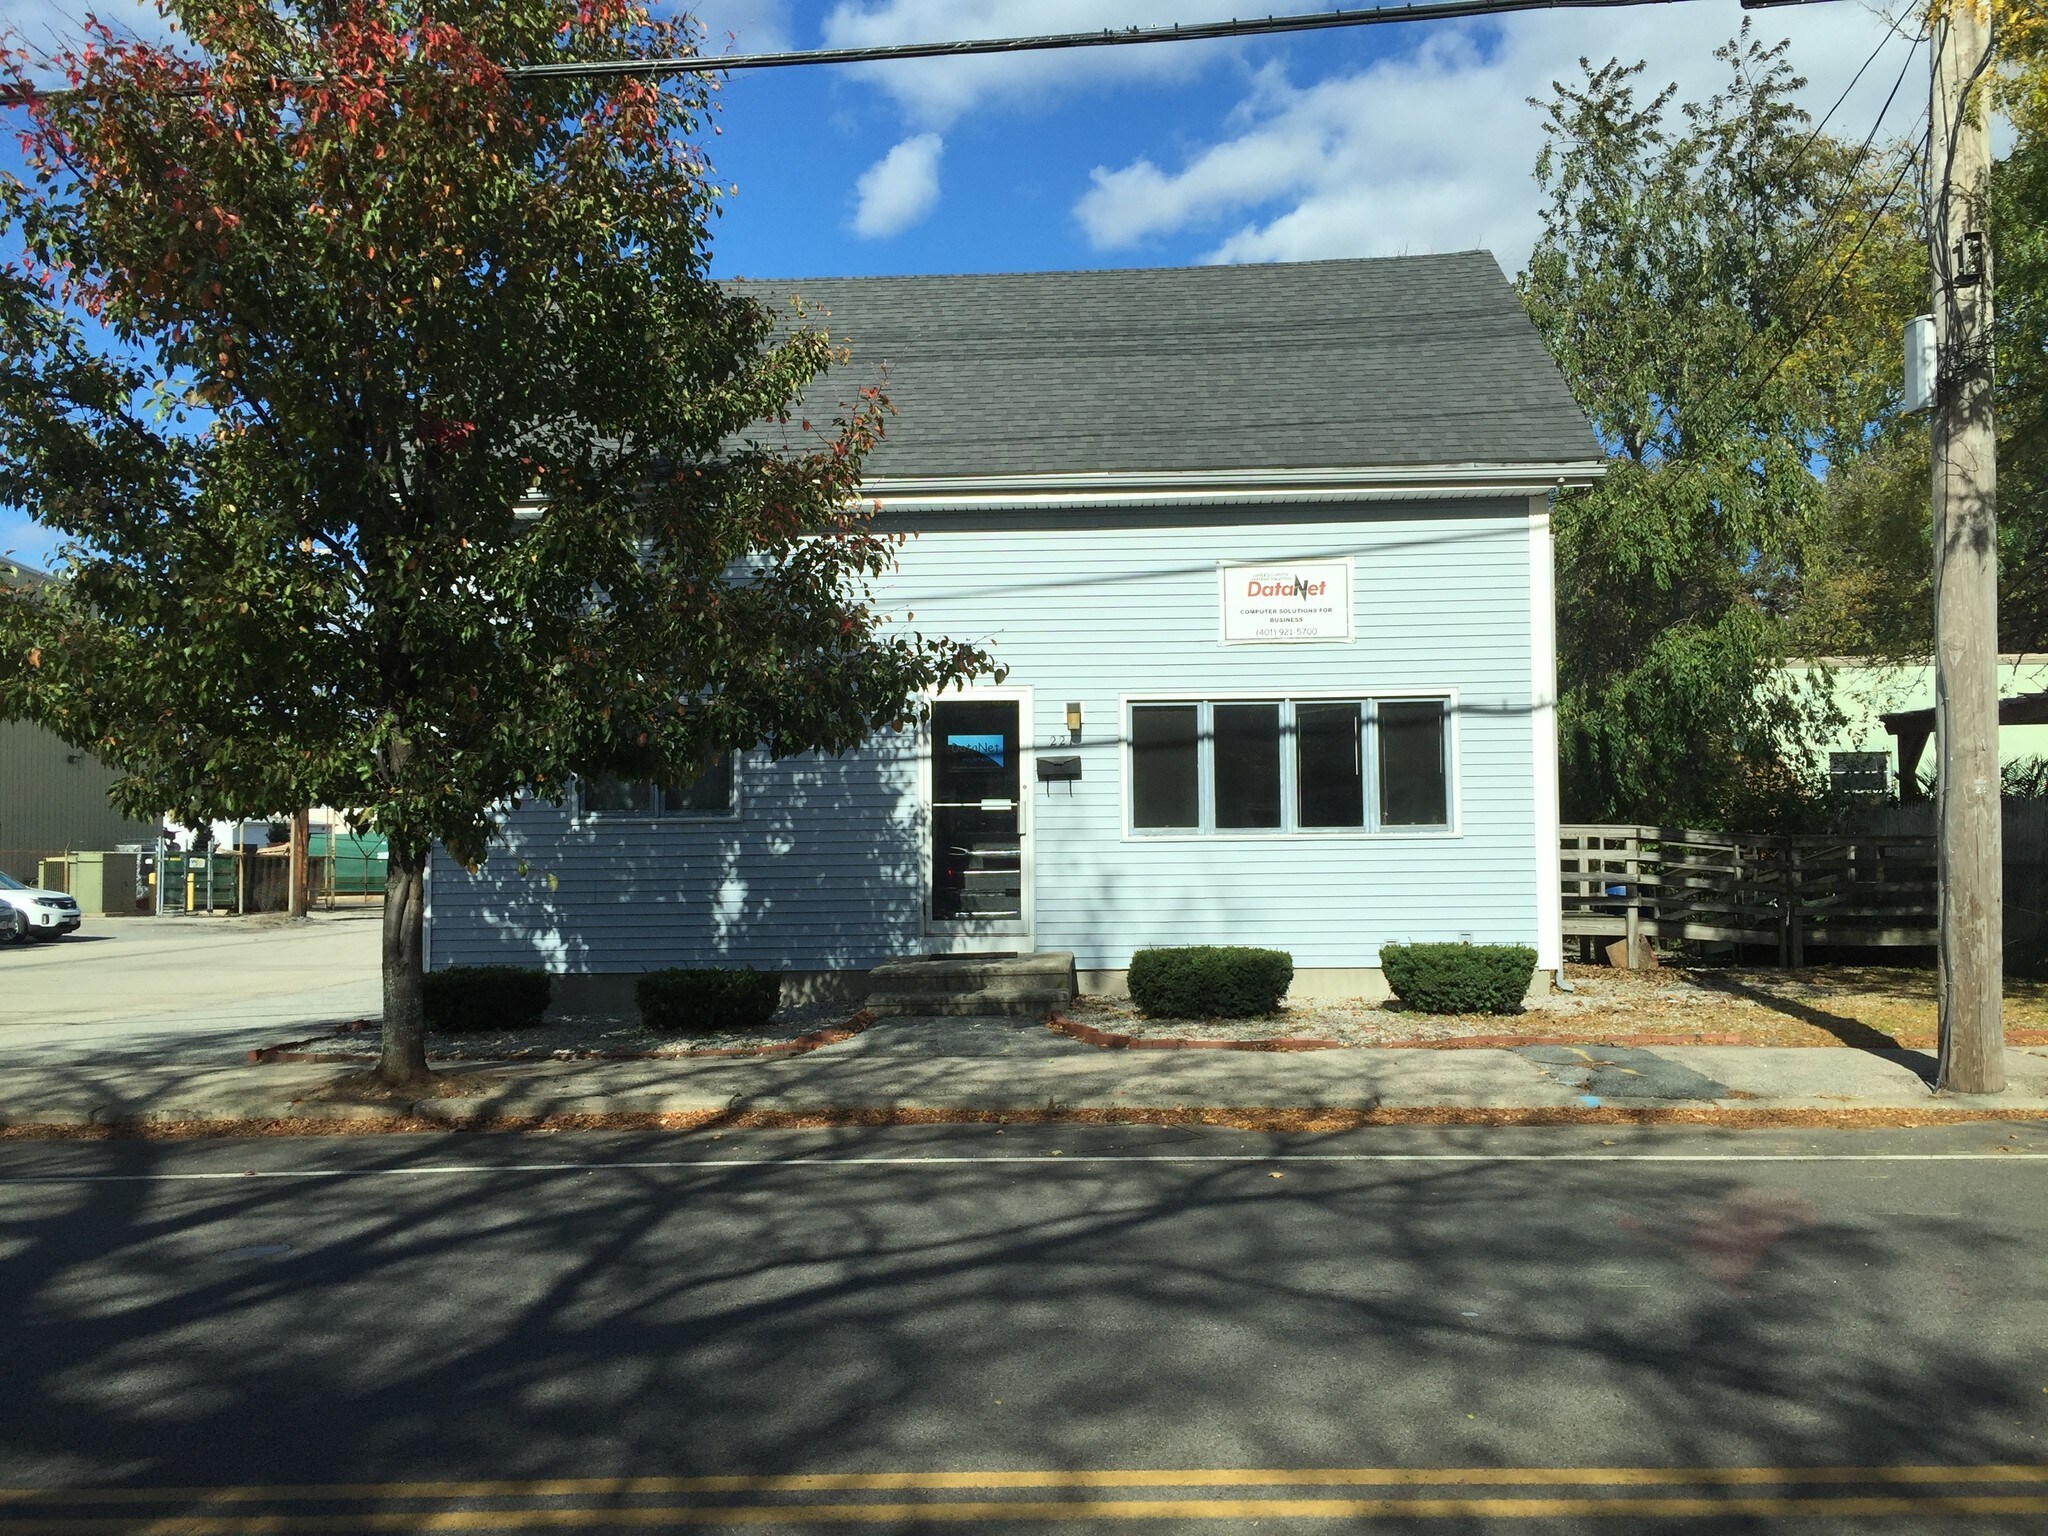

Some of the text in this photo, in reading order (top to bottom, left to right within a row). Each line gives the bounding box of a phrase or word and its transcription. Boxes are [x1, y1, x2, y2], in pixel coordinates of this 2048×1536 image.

[1247, 574, 1326, 602] DataNet
[1255, 627, 1318, 636] (401) 921-5700
[951, 742, 1000, 753] DataNet
